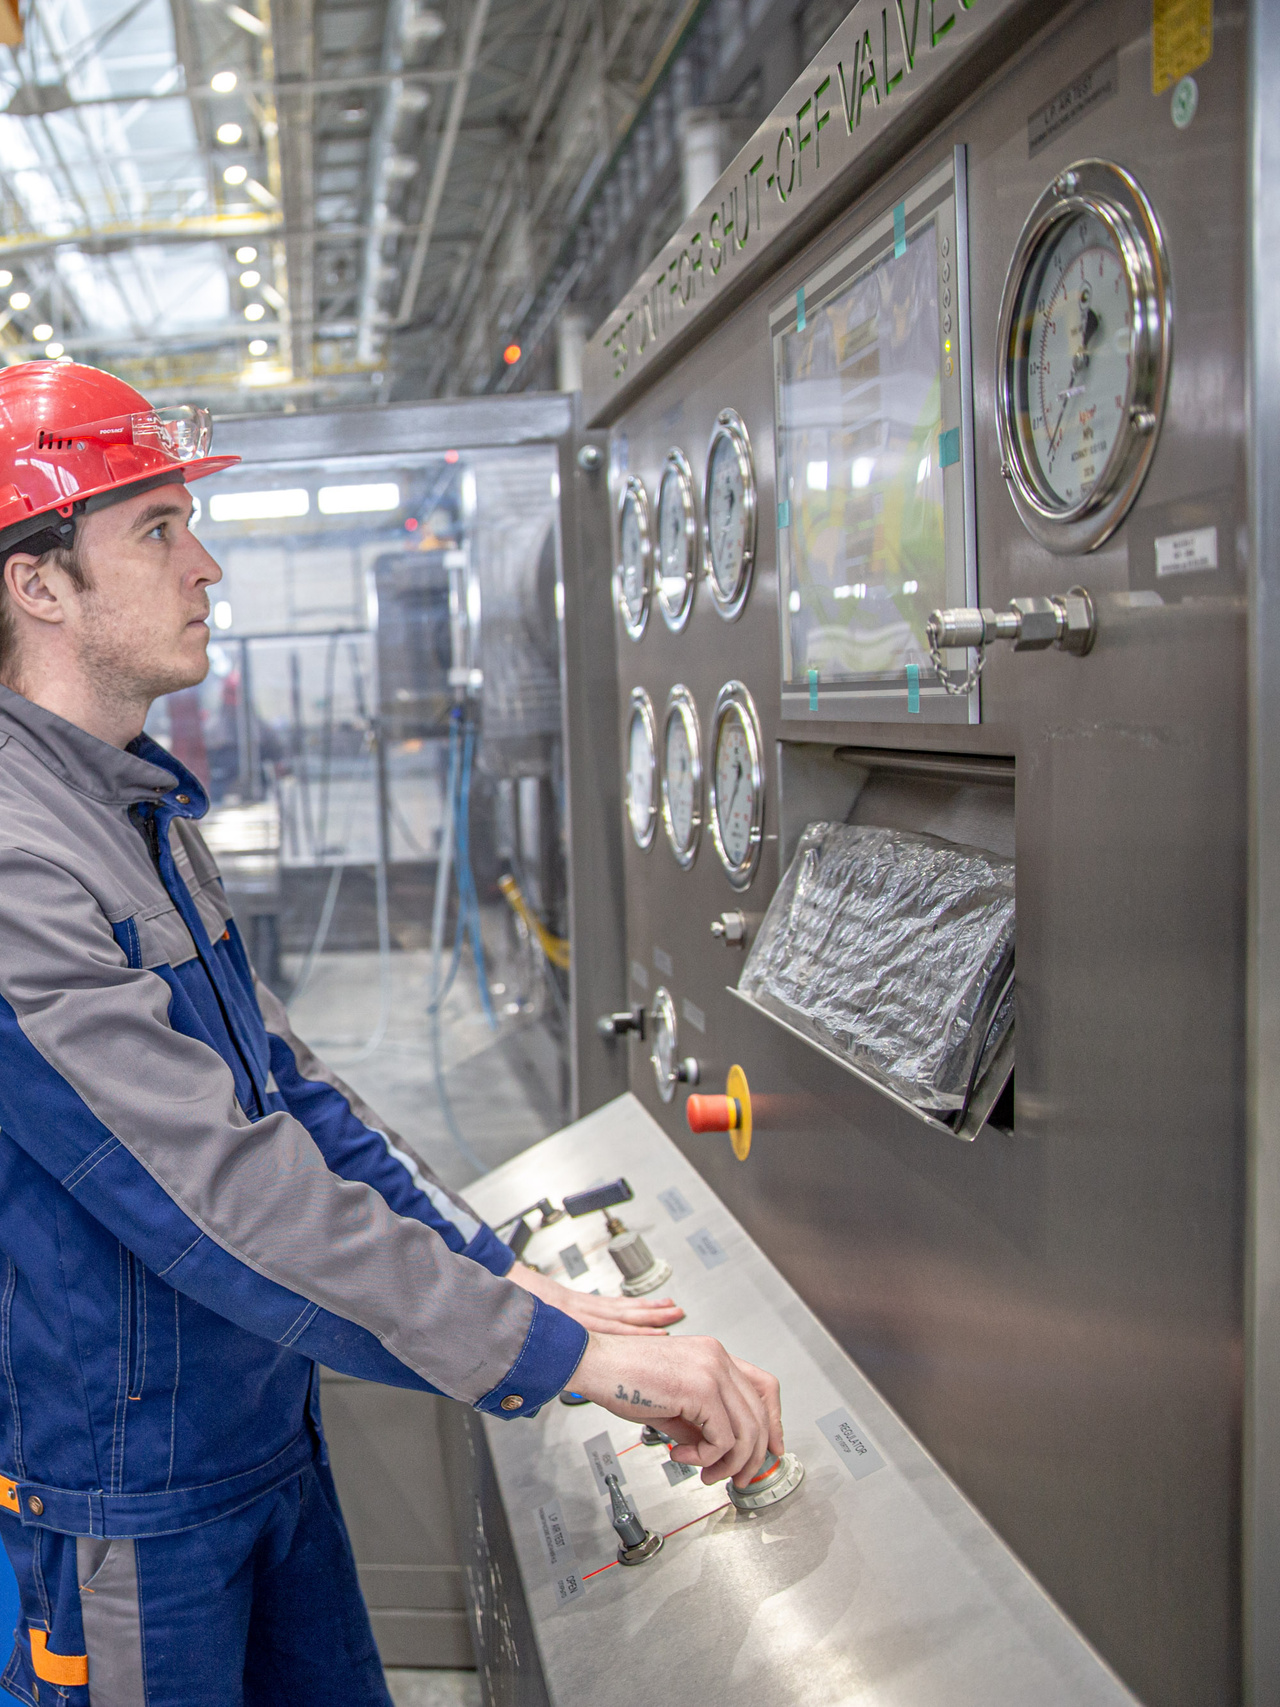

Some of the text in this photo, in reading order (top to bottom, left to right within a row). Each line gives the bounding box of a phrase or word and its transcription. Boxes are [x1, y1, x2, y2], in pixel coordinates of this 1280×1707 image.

[669, 231, 706, 307] FOR
[709, 75, 831, 276] SHUT-OFF
[838, 1422, 868, 1456] REGULATOR
[554, 1532, 566, 1548] TEST
[566, 1575, 579, 1594] OPEN
